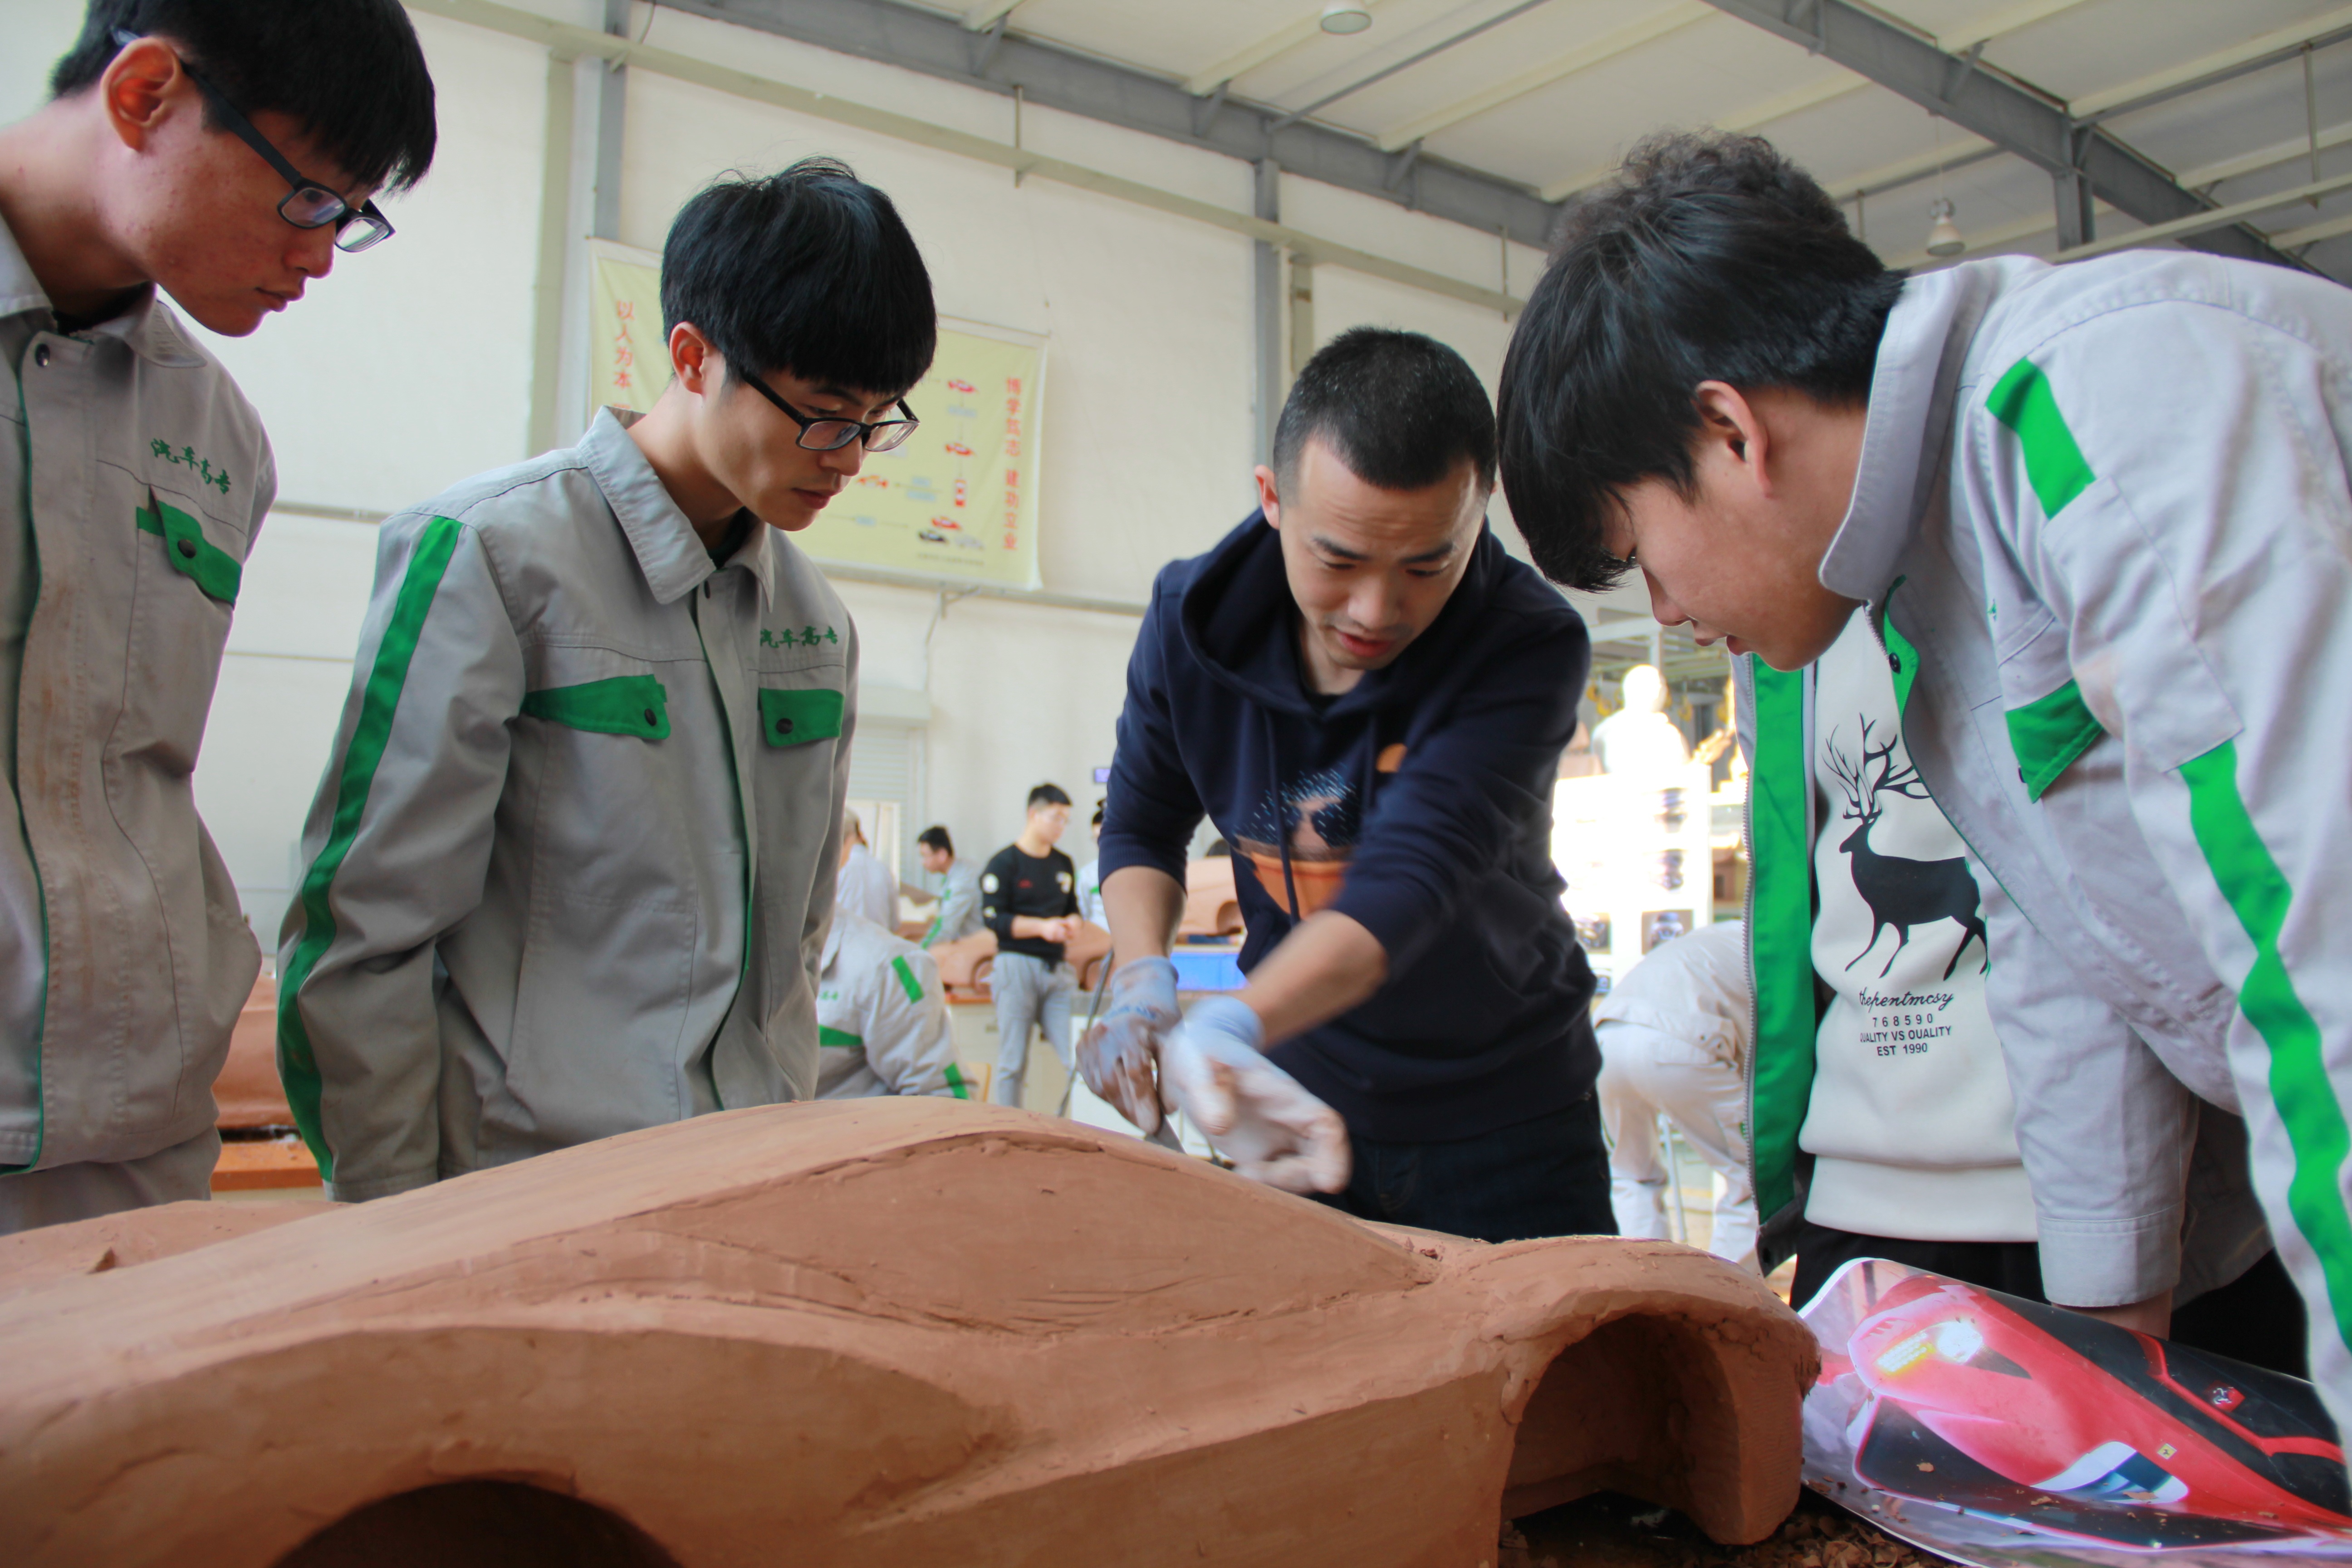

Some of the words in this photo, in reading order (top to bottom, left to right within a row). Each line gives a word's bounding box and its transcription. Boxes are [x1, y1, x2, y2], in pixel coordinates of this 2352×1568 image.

[614, 300, 635, 389] 以人为本
[1891, 1030, 1905, 1041] VS
[1877, 1045, 1896, 1056] EST
[1903, 1043, 1928, 1054] 1990
